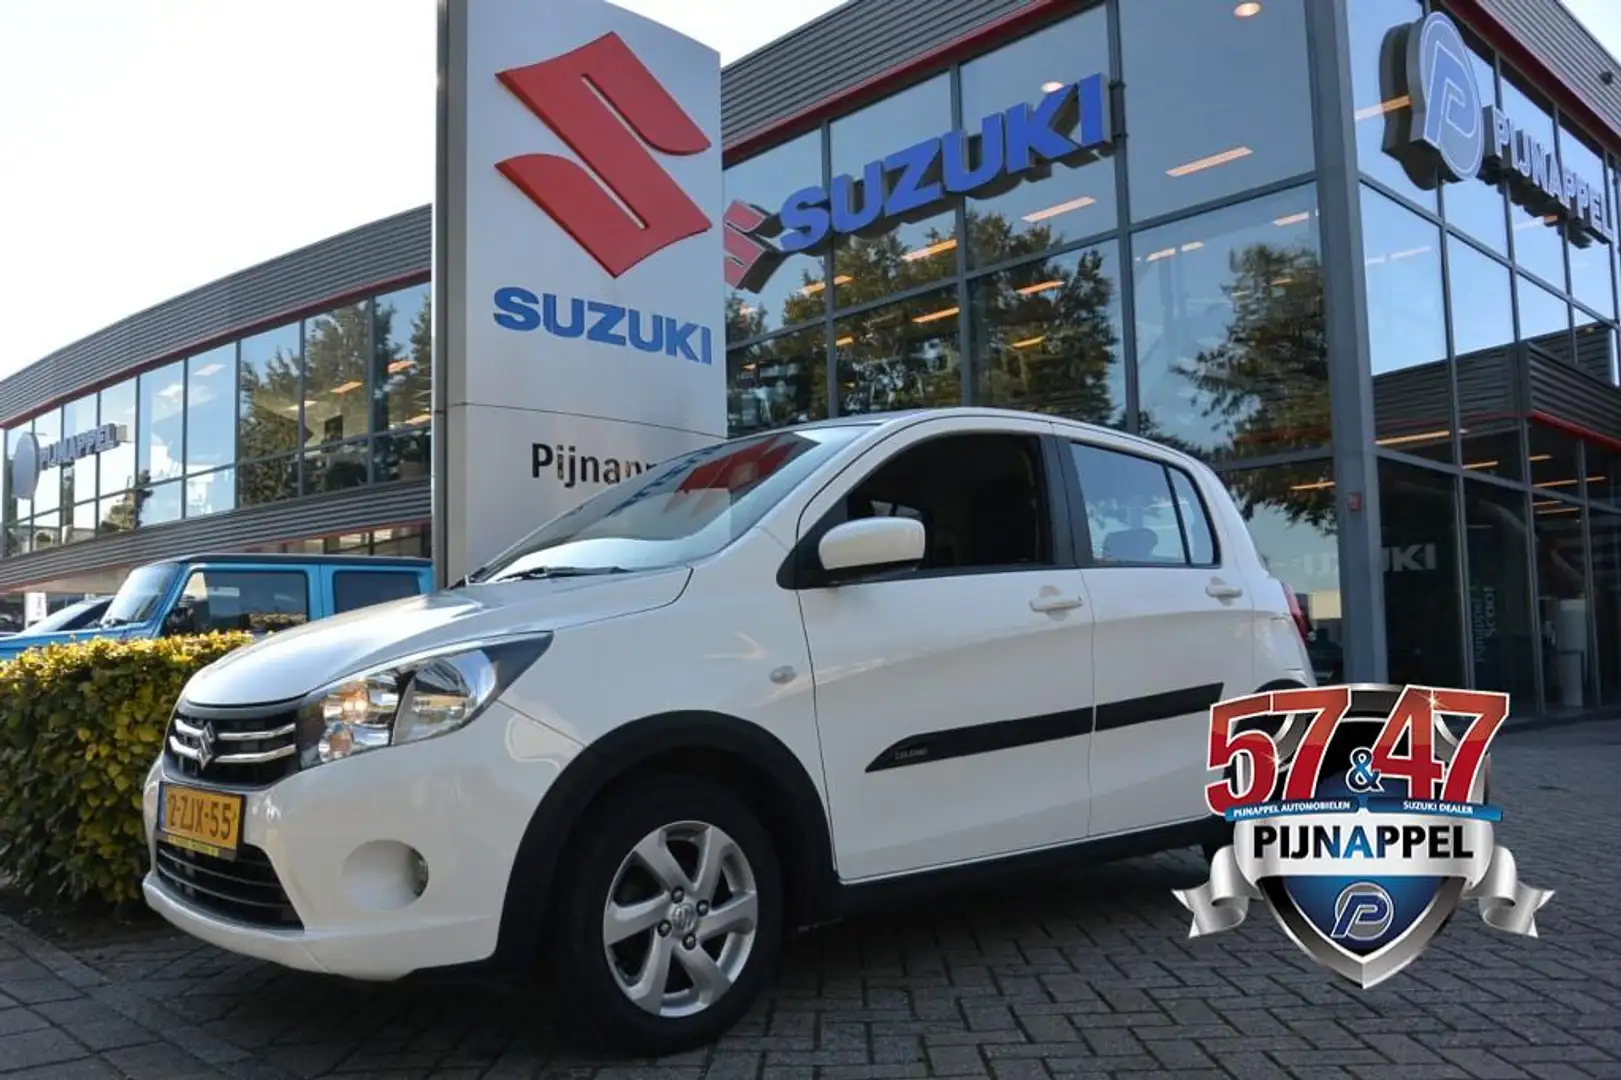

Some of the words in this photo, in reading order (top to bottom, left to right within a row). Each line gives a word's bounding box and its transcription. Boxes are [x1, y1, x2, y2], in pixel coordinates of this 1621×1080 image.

[779, 73, 1109, 252] SUZUKI
[1490, 104, 1613, 243] PIJNAPPEL
[493, 287, 712, 365] SUZUKI
[532, 442, 657, 488] Pijna
